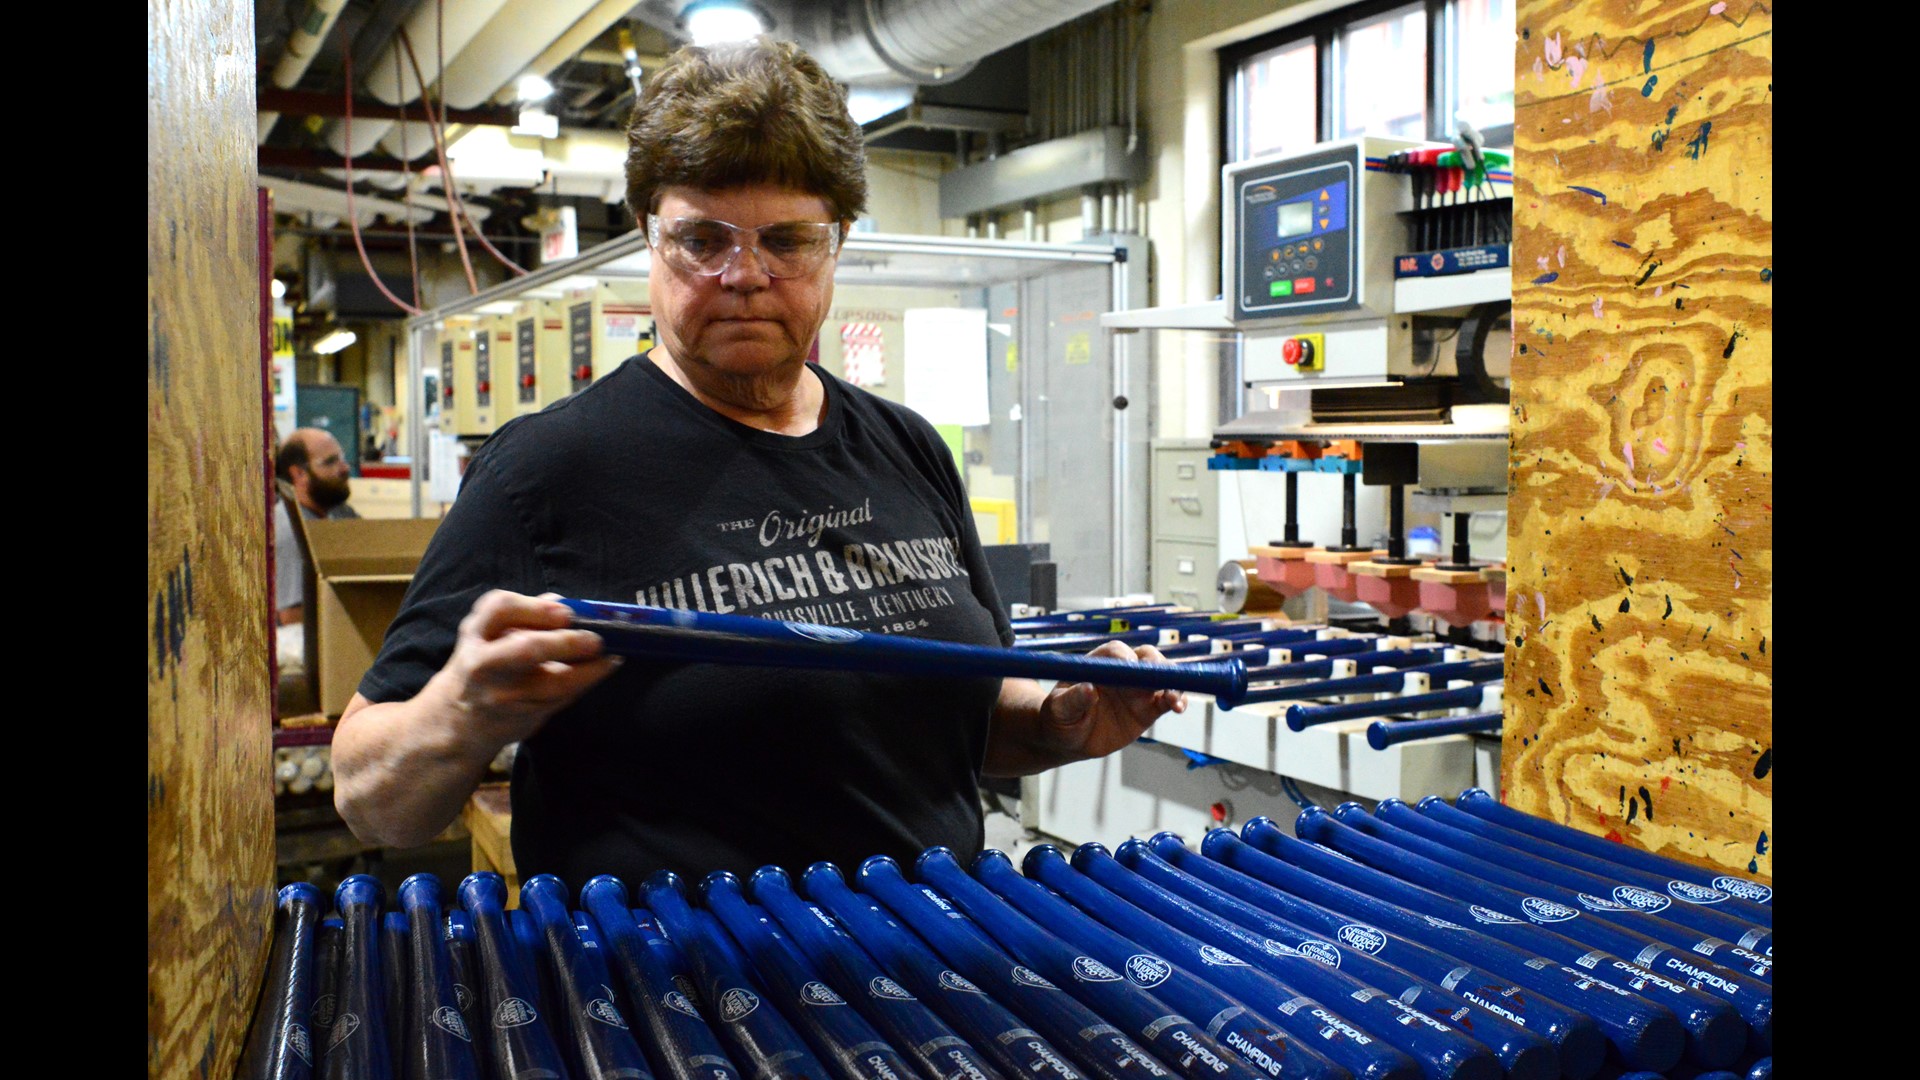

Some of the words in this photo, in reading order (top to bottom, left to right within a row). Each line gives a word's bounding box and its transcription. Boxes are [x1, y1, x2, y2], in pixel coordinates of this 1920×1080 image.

[716, 518, 756, 533] THE
[758, 497, 873, 548] Original
[815, 550, 850, 594] &
[869, 585, 955, 617] KENTUCKY
[881, 618, 930, 635] 1884
[1616, 887, 1666, 908] Slugger
[1672, 881, 1725, 900] Slugger
[1716, 878, 1768, 900] Slugger
[1341, 927, 1381, 951] Slugger
[1129, 957, 1164, 982] Slugger
[1612, 961, 1686, 994] CHAMPIONS
[1665, 958, 1740, 995] CHAMPIONS
[1311, 1009, 1372, 1045] CHAMPIONS
[1028, 1041, 1078, 1080] CHAMPIONS
[1111, 1037, 1167, 1077] CHAMPIONS
[1172, 1030, 1229, 1073] CHAMPIONS
[1226, 1031, 1282, 1076] CHAMPIONS
